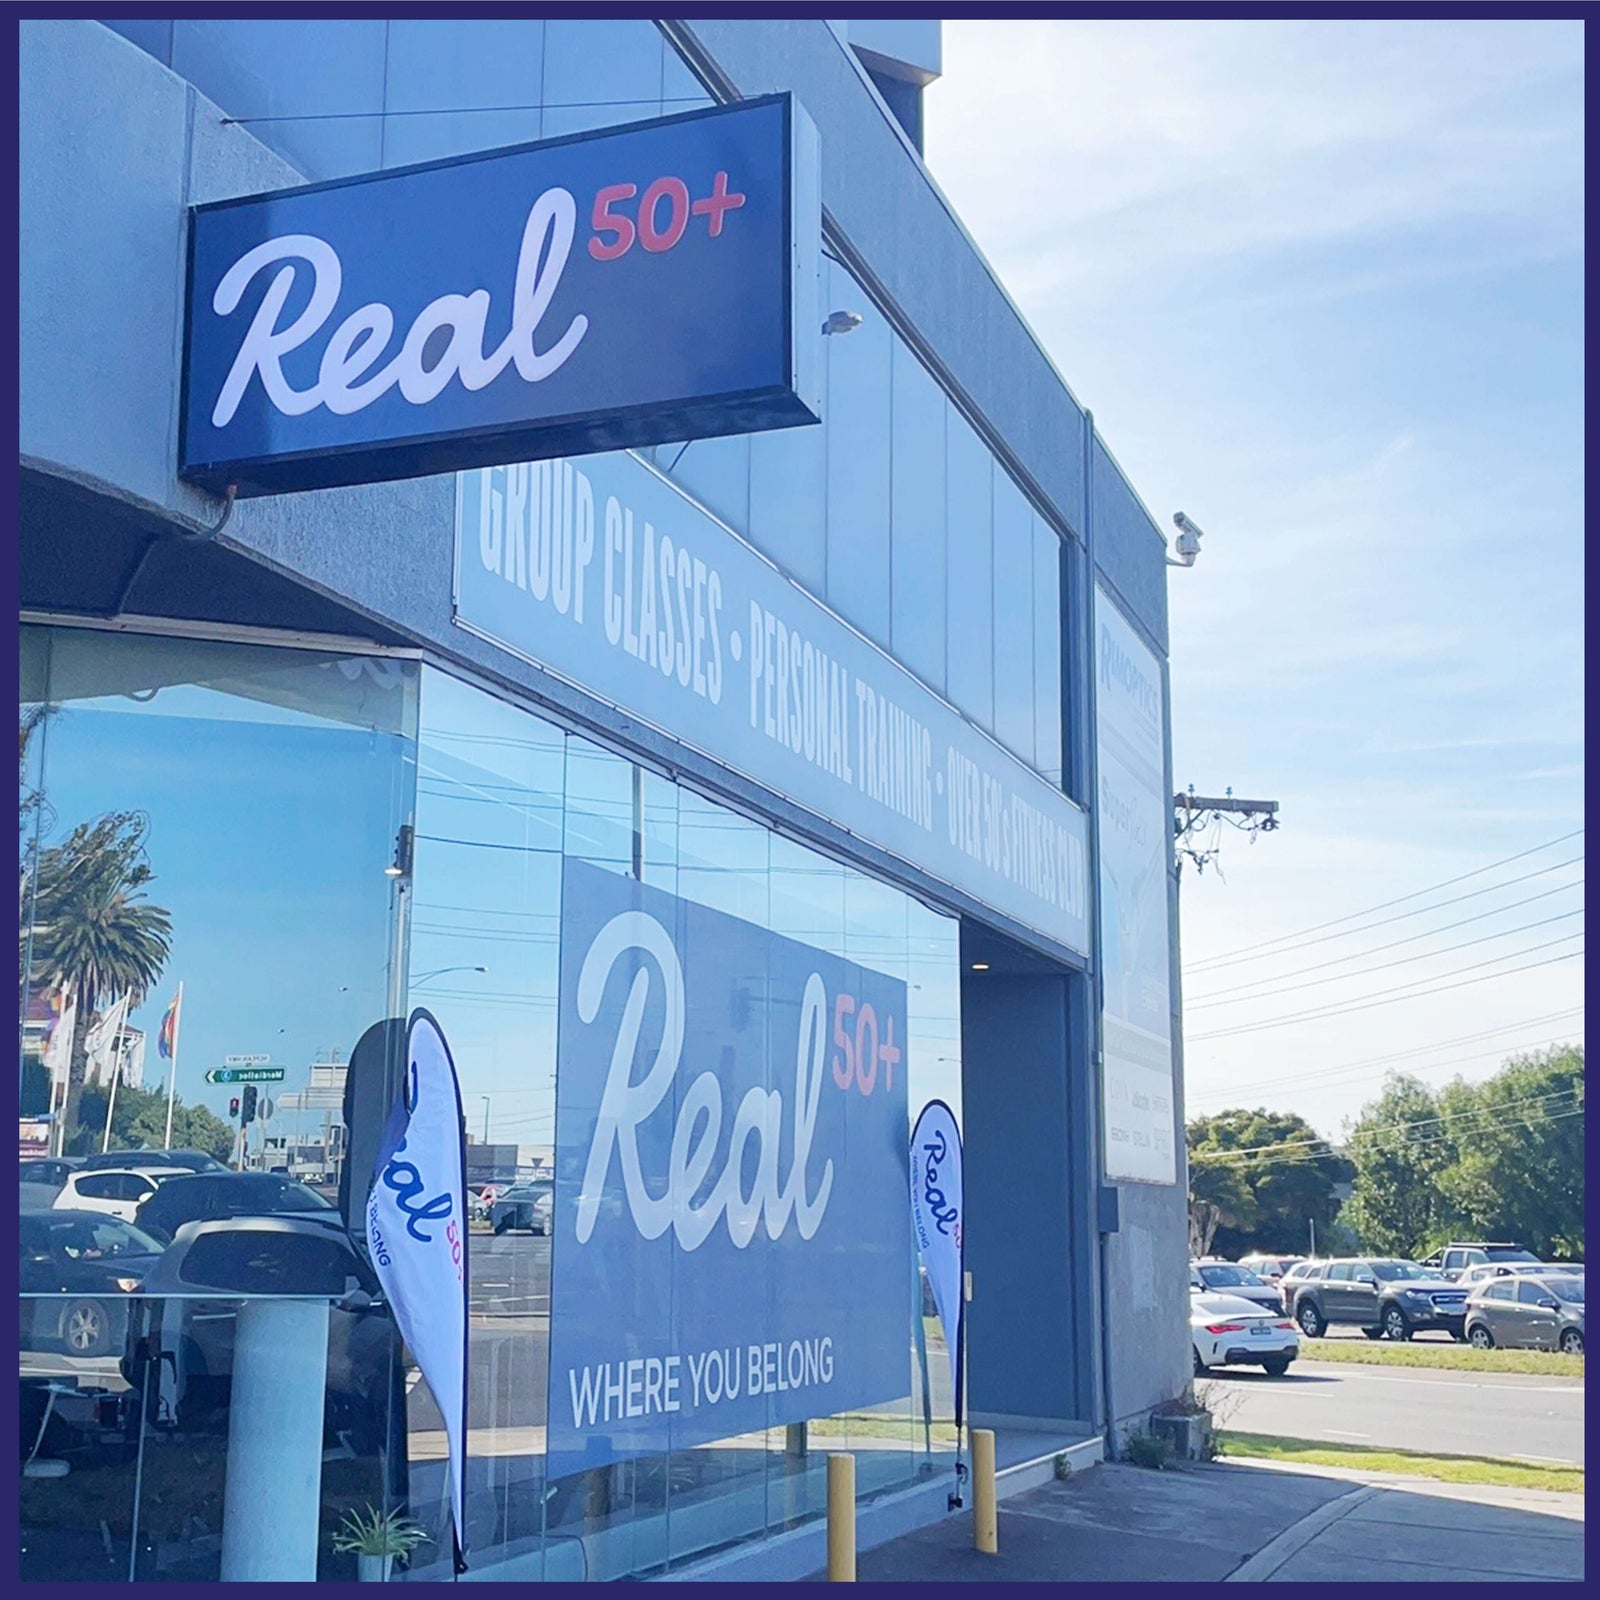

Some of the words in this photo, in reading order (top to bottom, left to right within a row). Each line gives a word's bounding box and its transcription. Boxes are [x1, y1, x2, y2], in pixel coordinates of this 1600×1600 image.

[211, 187, 590, 428] Real
[588, 170, 747, 262] 50+
[479, 457, 595, 625] GROUP
[604, 495, 723, 705] CLASSES
[750, 599, 853, 785] PERSONAL
[855, 677, 933, 833] TRAINING
[947, 744, 982, 862] OVER
[1011, 793, 1057, 906] FITNESS
[1057, 824, 1084, 921] CLUB
[575, 910, 835, 1253] Real
[831, 992, 901, 1097] 50+
[923, 1130, 958, 1236] Real
[568, 1354, 681, 1429] WHERE
[686, 1348, 742, 1409] YOU
[746, 1335, 834, 1404] BELONG
